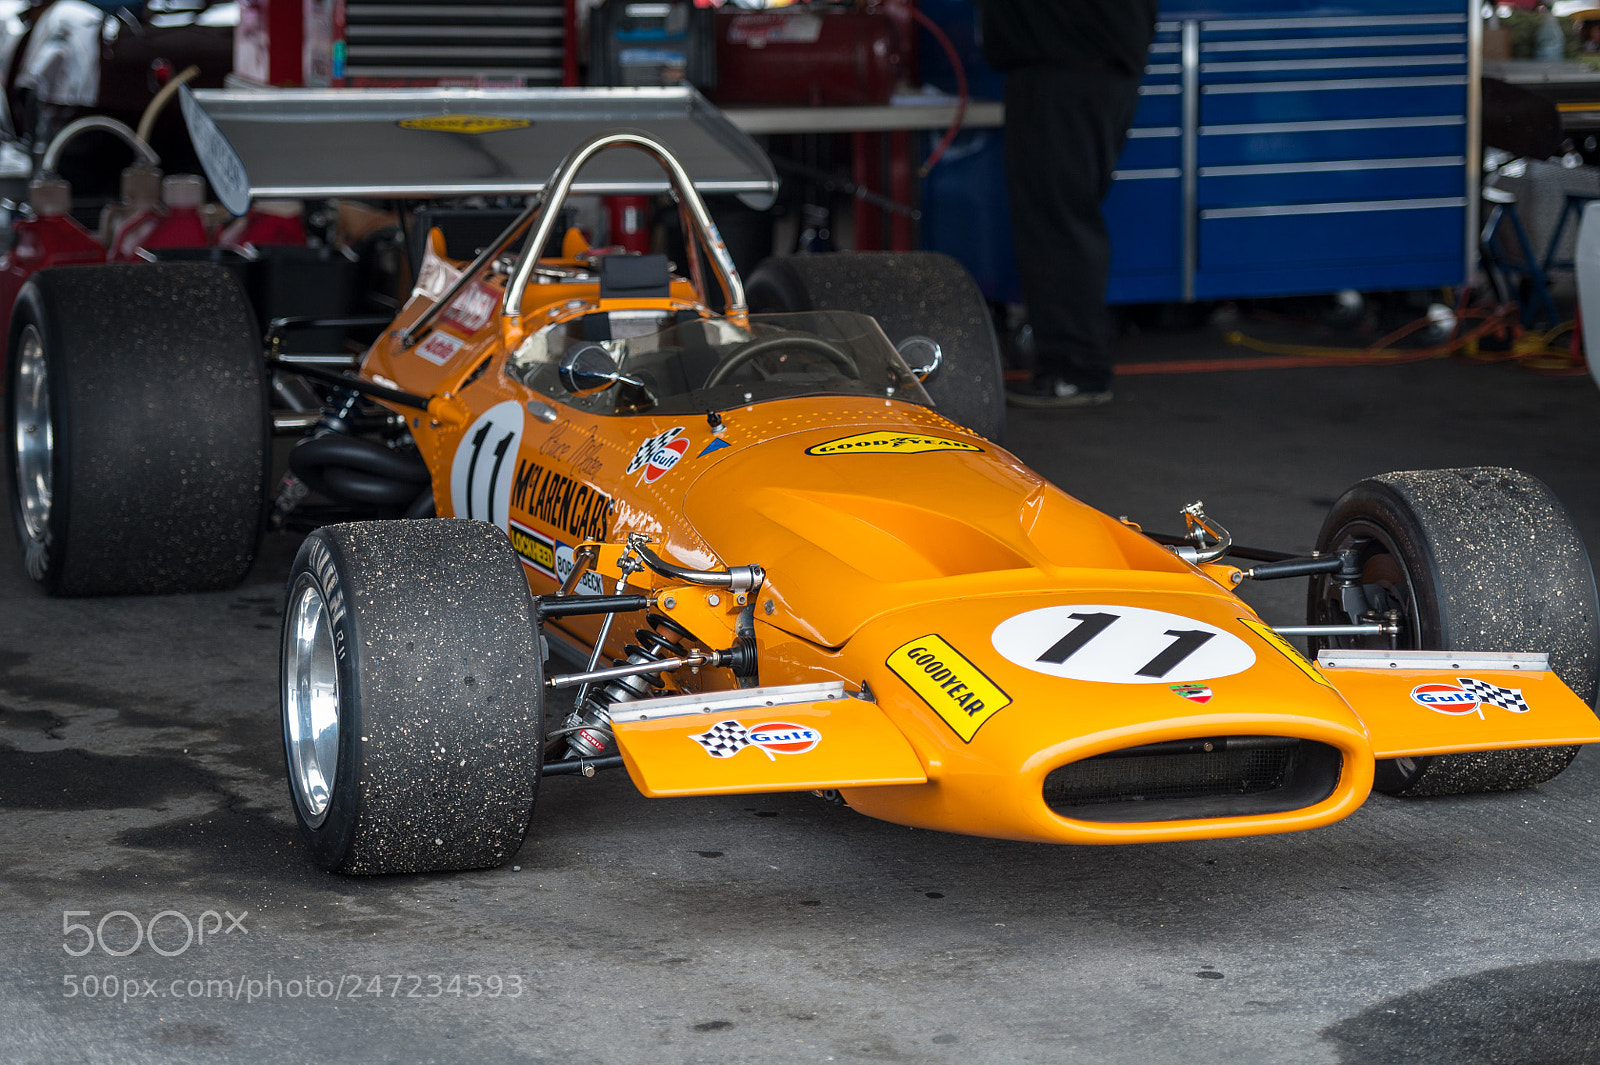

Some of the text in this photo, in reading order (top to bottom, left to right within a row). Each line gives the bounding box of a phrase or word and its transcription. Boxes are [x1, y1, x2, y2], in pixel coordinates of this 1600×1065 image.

[652, 449, 679, 468] Gulf
[819, 437, 969, 453] GOODYEAR
[466, 420, 515, 523] 11
[510, 529, 555, 569] LOCKHEED
[557, 555, 603, 595] BOR BECK
[1035, 612, 1217, 679] 11
[907, 647, 985, 718] GOODYEAR
[1416, 692, 1475, 703] Gulf
[750, 730, 814, 742] Gulf
